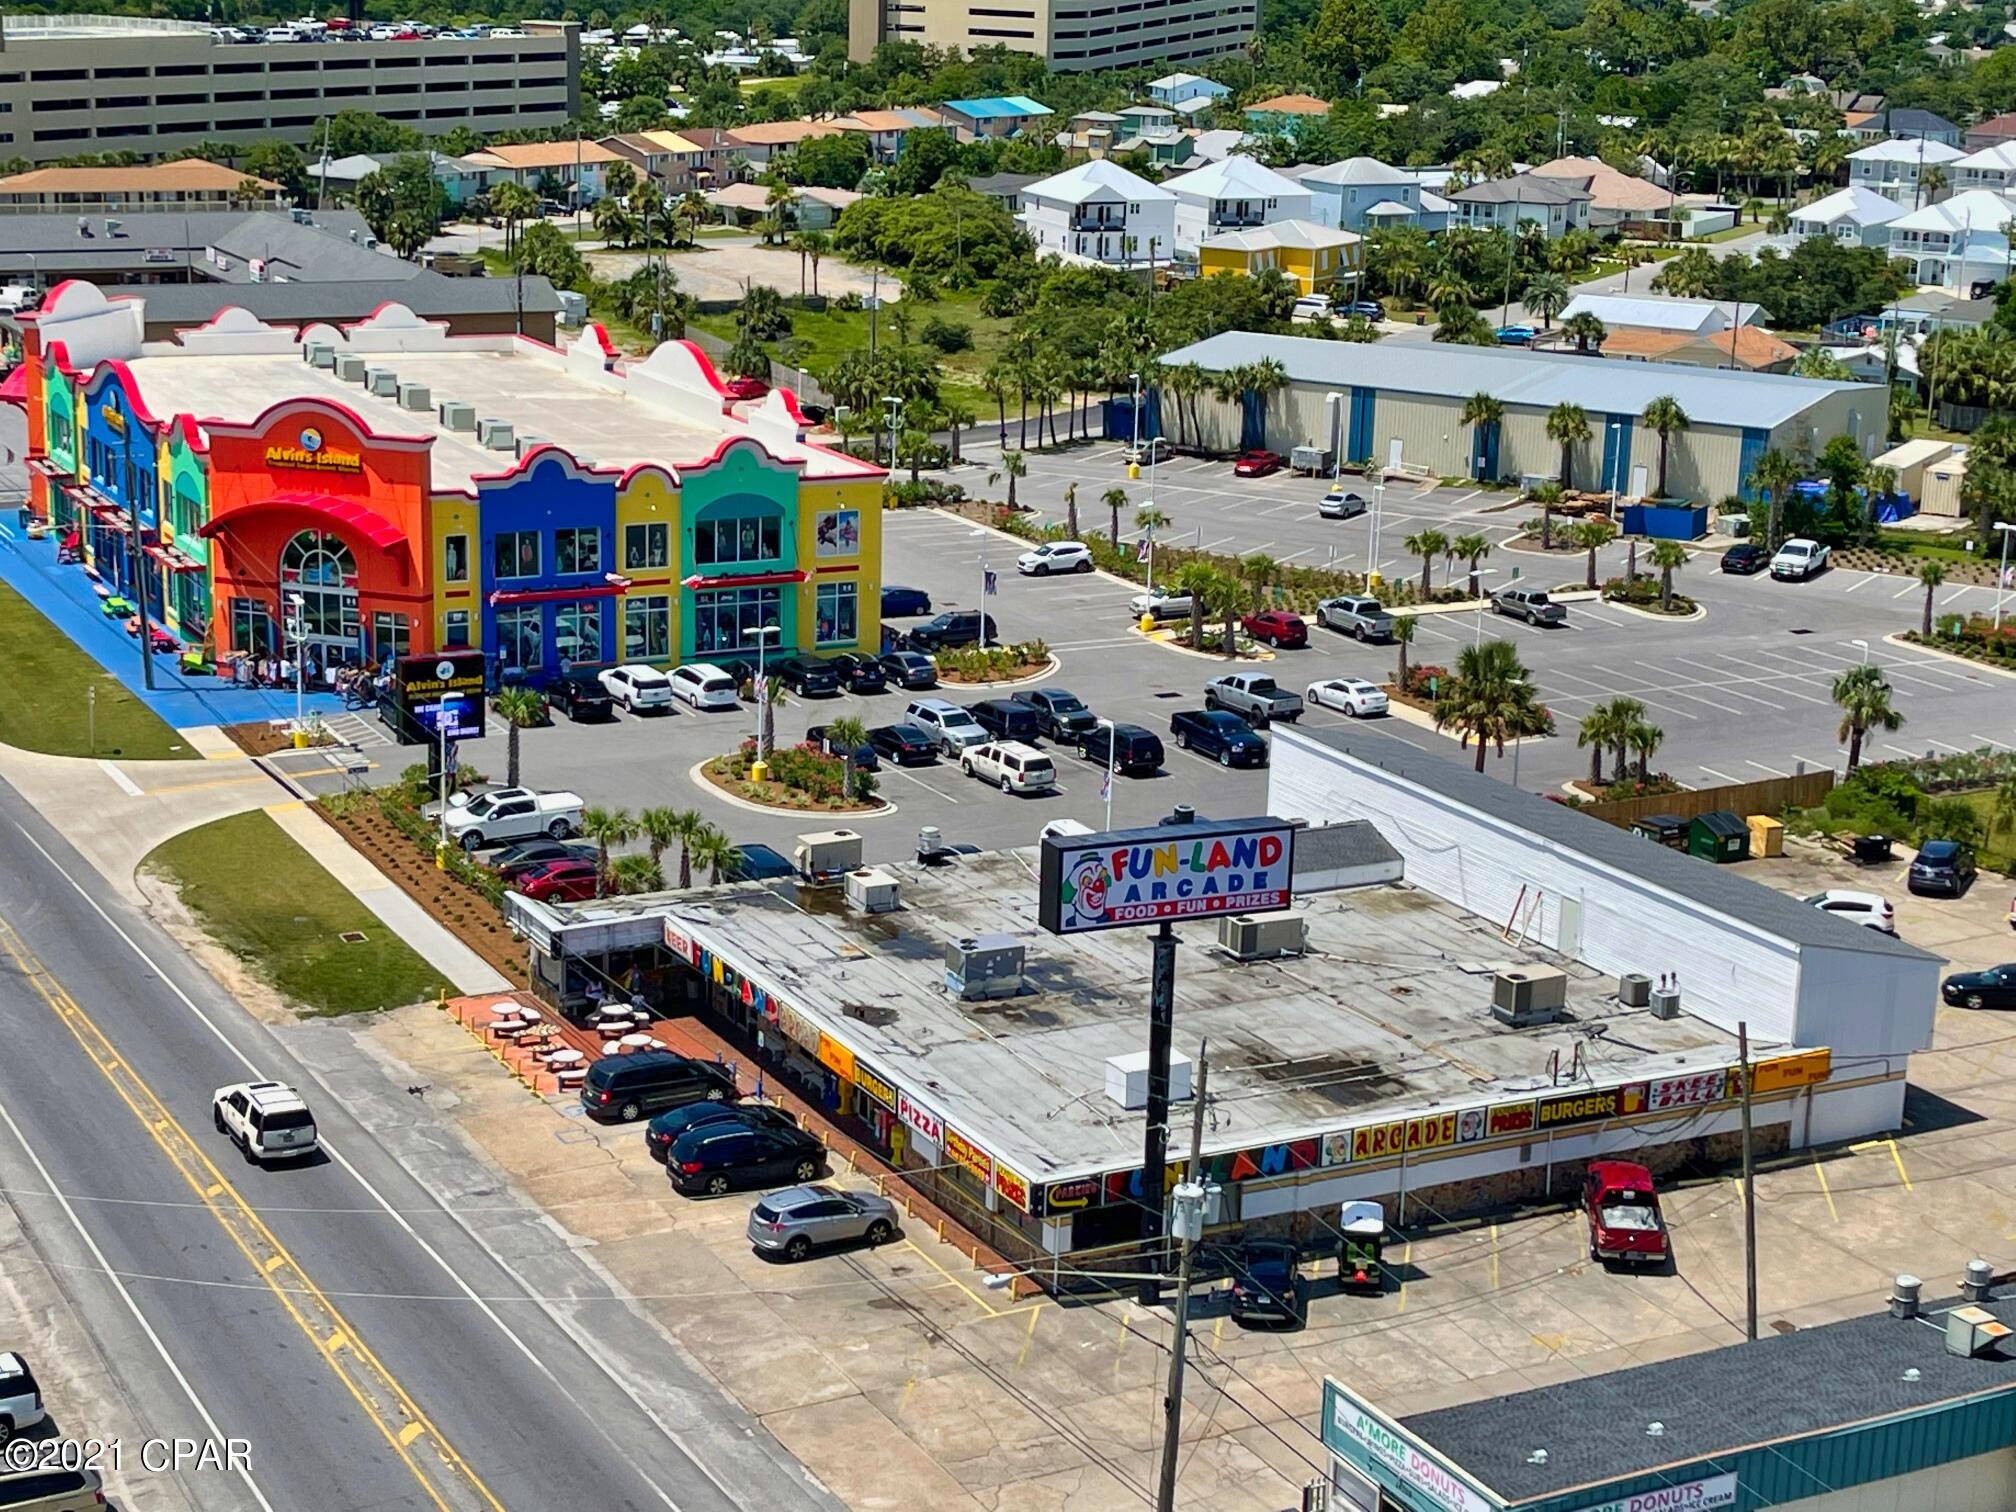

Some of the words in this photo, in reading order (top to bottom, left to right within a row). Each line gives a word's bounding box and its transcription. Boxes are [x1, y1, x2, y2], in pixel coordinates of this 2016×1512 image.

[265, 446, 312, 463] Alvin's
[316, 451, 360, 467] Island
[406, 679, 446, 692] Alvin's
[448, 674, 483, 688] Island
[1111, 835, 1283, 881] FUN-LAND
[1124, 871, 1269, 903] ARCADE
[1114, 904, 1158, 920] FOOD
[1177, 898, 1207, 914] FUN
[1225, 891, 1280, 908] PRIZES
[855, 1063, 894, 1108] BURGERS
[1783, 1066, 1803, 1077] FUN
[900, 1097, 941, 1142] PIZZA
[1540, 1094, 1616, 1122] BURGERS
[1356, 1115, 1454, 1156] ARCADE
[1356, 1415, 1406, 1461] A'MORE
[1411, 1453, 1465, 1505] DONUTS
[1630, 1483, 1704, 1512] DONUTS
